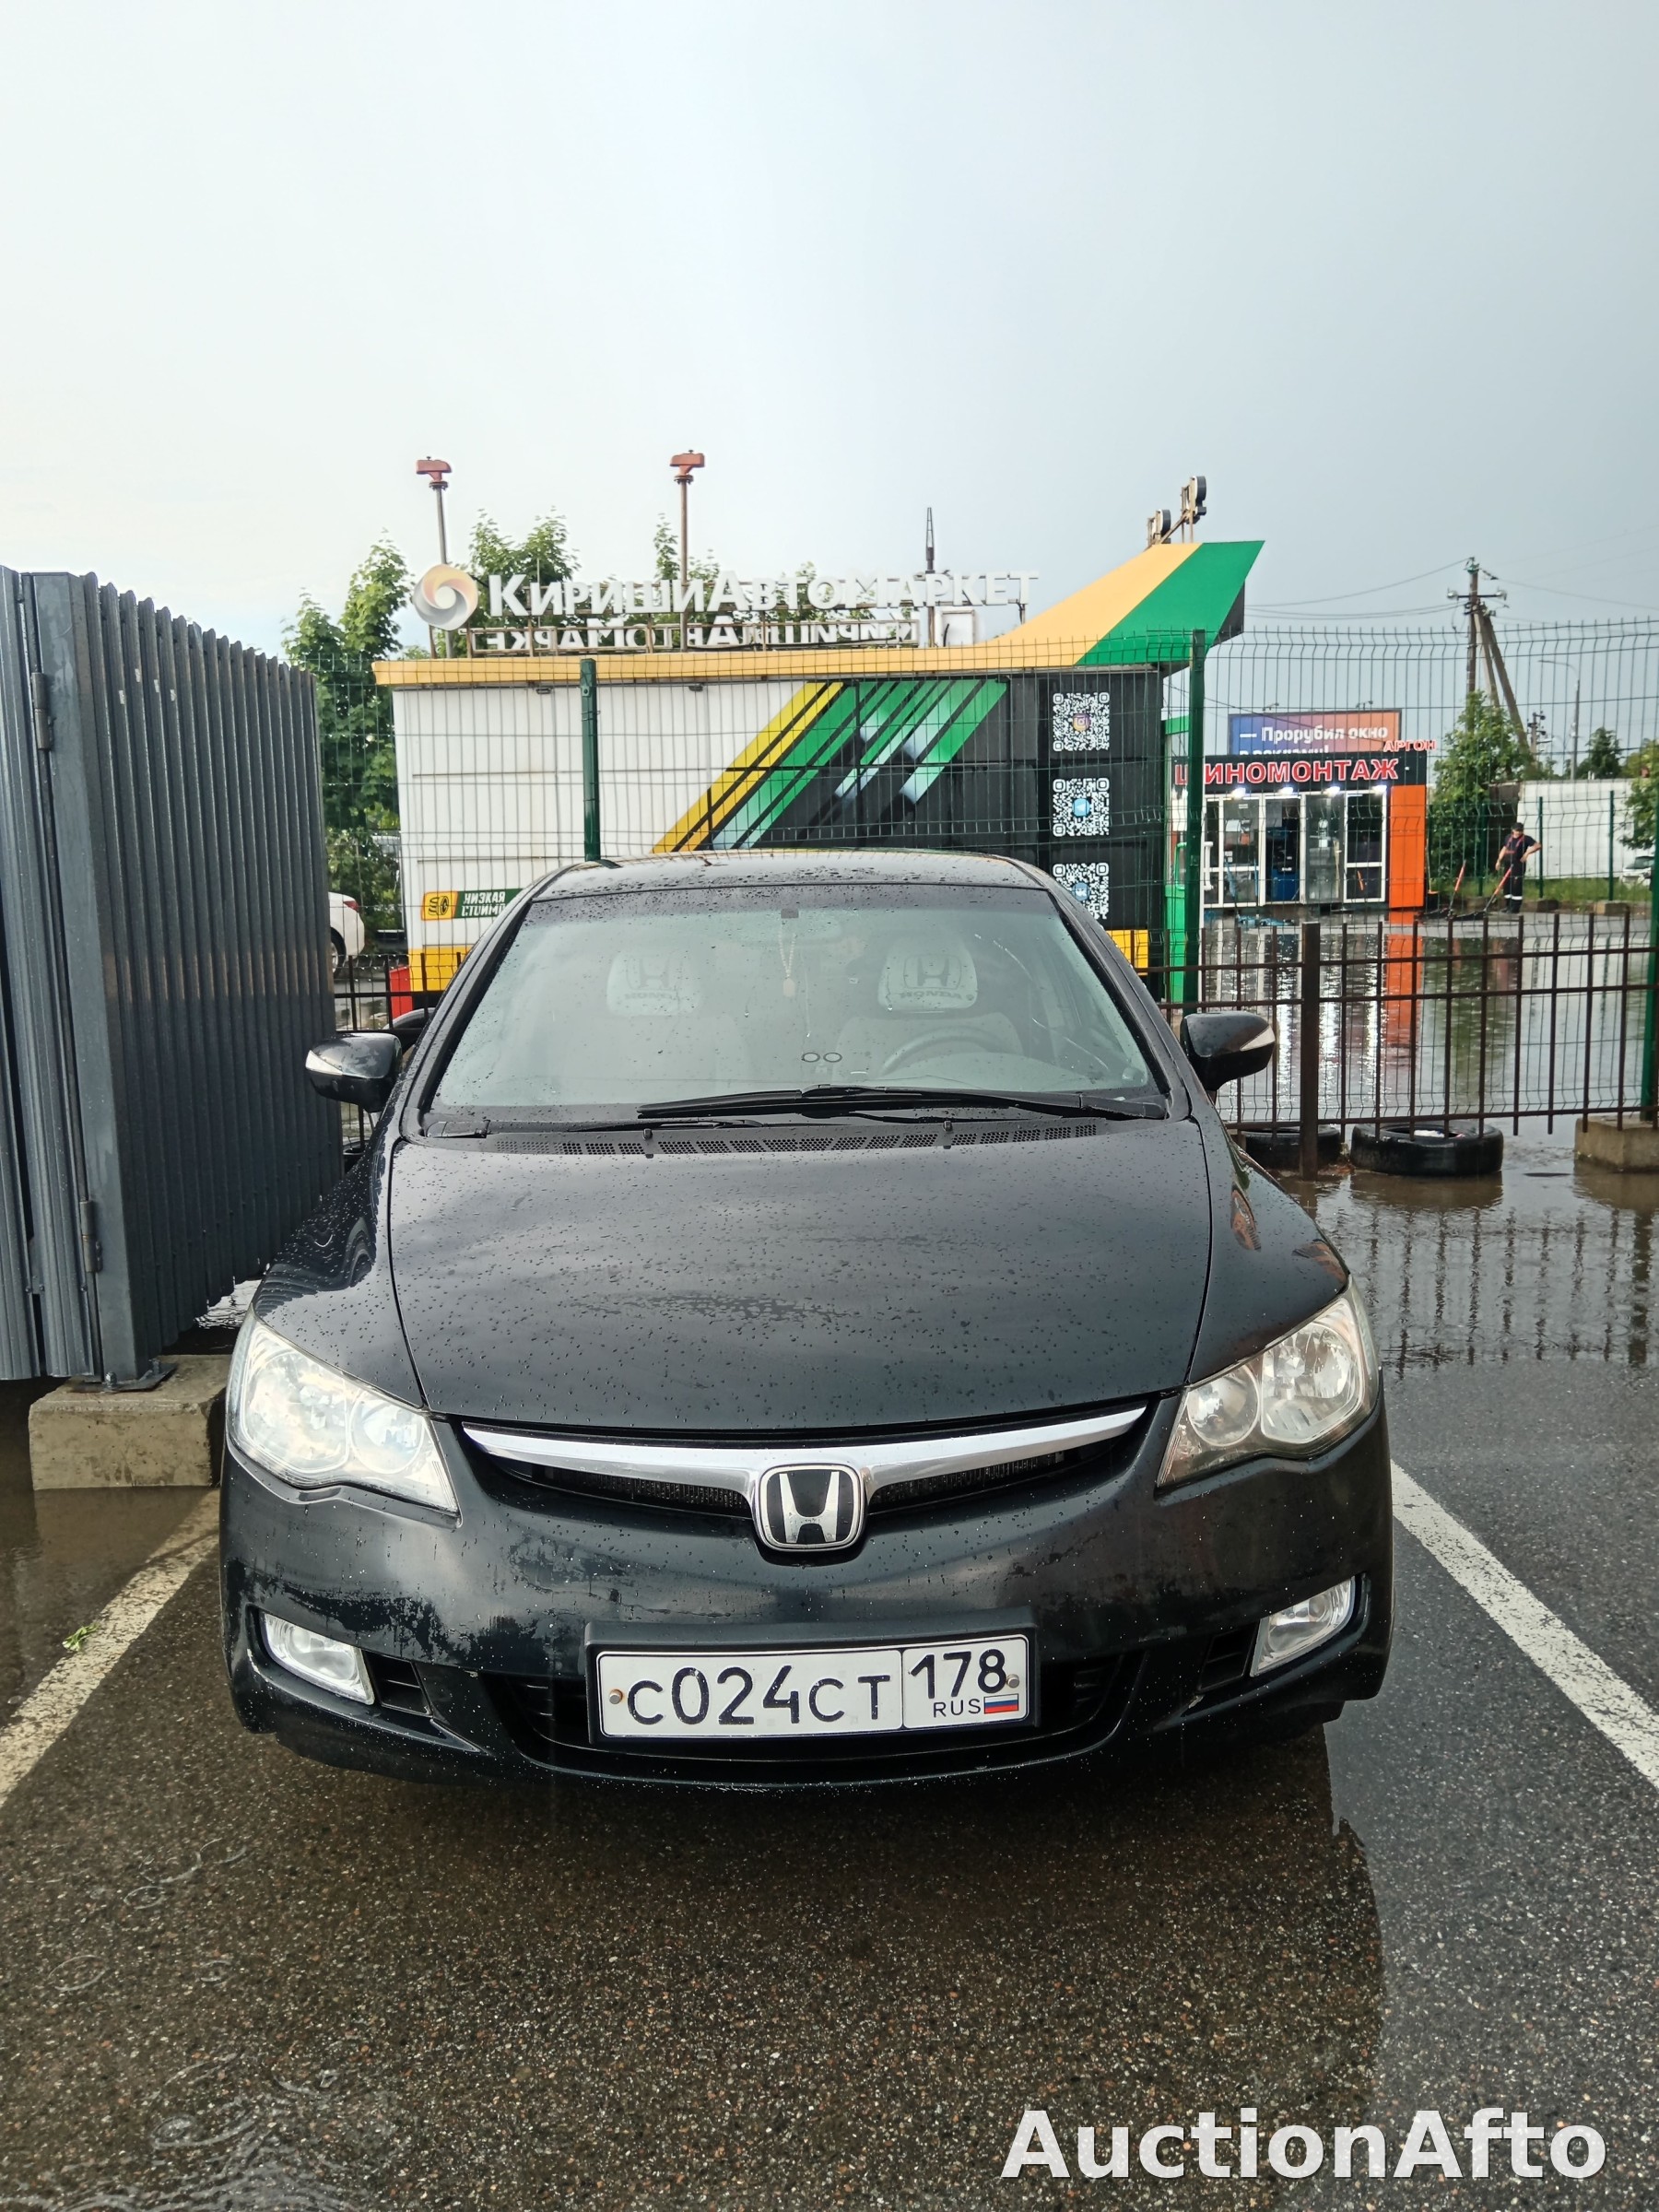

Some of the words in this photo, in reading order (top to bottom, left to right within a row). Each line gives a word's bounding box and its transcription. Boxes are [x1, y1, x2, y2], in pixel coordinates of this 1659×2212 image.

[1262, 724, 1345, 745] Прорубил
[1348, 726, 1388, 739] окно
[1383, 739, 1438, 753] АРГОН
[464, 891, 506, 904] НИЗКАЯ
[627, 1665, 891, 1725] С024СТ
[908, 1649, 1007, 1700] 178
[933, 1698, 981, 1718] RUS
